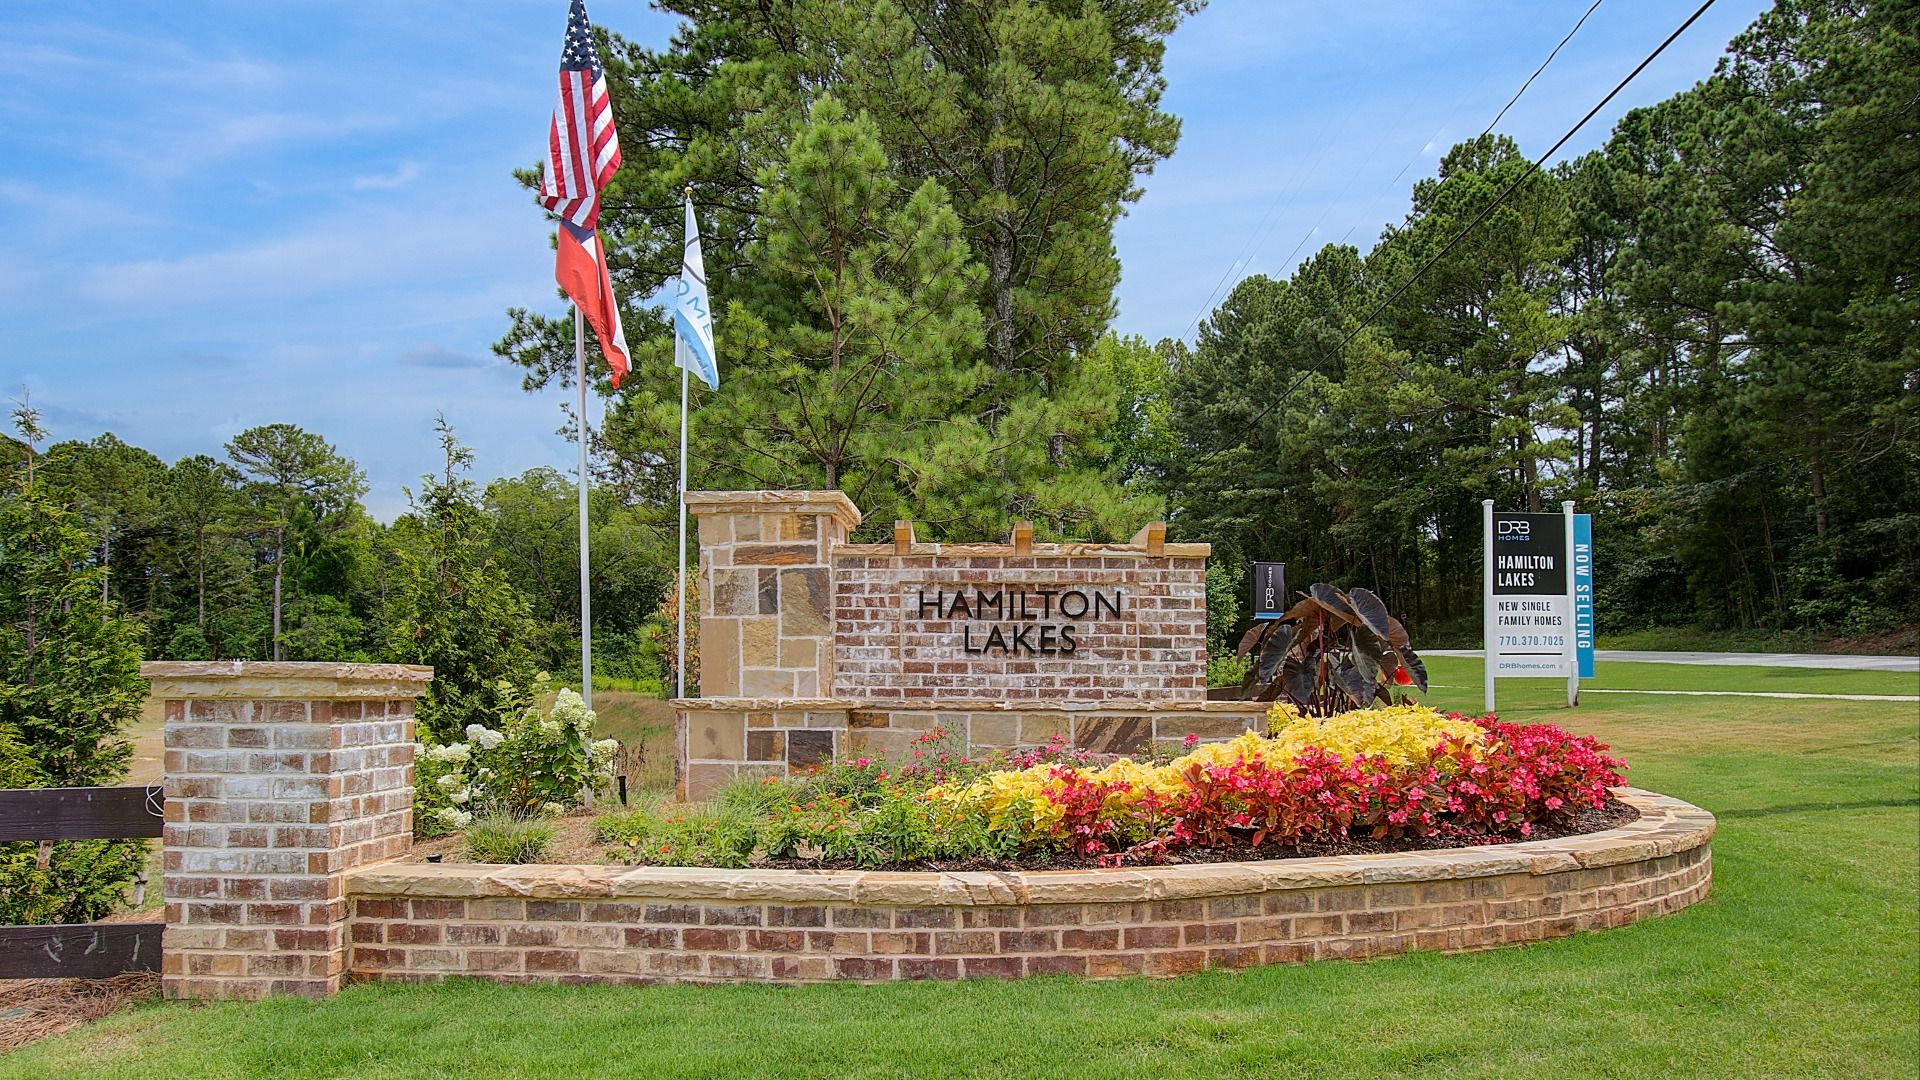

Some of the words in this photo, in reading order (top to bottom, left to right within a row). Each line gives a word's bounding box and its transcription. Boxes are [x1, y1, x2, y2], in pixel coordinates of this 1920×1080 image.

[1498, 520, 1530, 534] DRB
[1498, 555, 1554, 570] HAMILTON
[1575, 544, 1589, 577] NOW
[1498, 572, 1535, 587] LAKES
[918, 590, 1121, 620] HAMILTON
[1265, 587, 1275, 609] DRB
[1498, 601, 1519, 612] NEW
[1521, 601, 1551, 612] SINGLE
[1498, 615, 1531, 626] FAMILY
[1534, 615, 1562, 626] HOMES
[1576, 584, 1591, 649] SELLING
[964, 625, 1077, 654] LAKES
[1499, 635, 1564, 646] 770.370.7025
